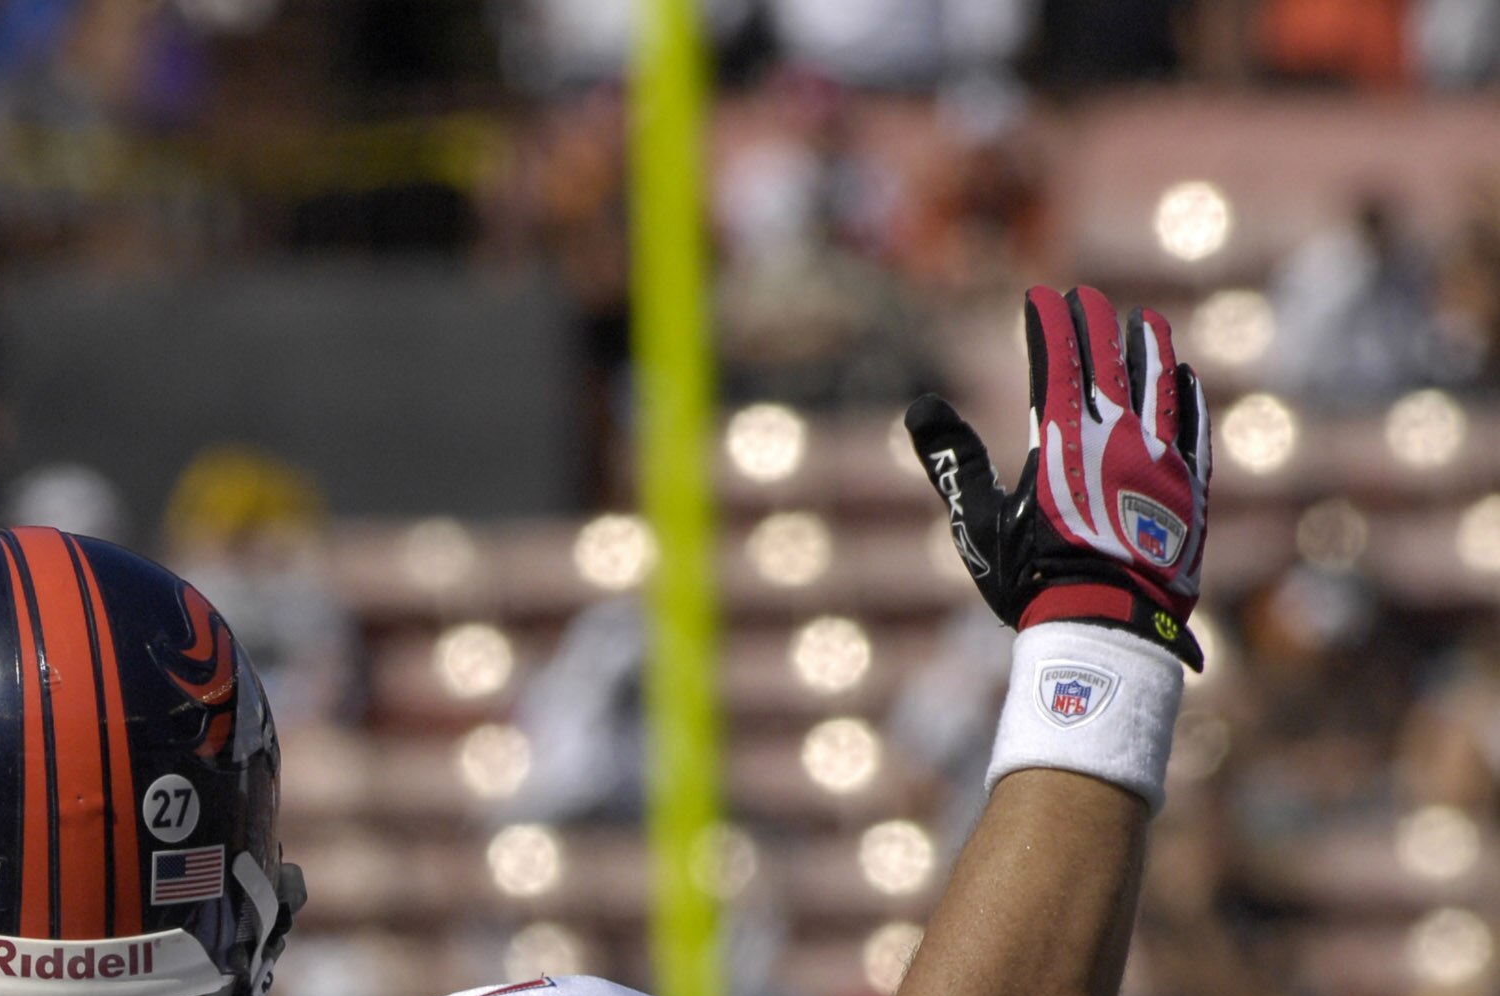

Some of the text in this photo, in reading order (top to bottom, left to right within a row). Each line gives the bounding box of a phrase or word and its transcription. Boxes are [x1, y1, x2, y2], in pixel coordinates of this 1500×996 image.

[1045, 671, 1107, 688] EQUIPMENT
[1053, 695, 1086, 714] NFL
[152, 788, 193, 829] 27
